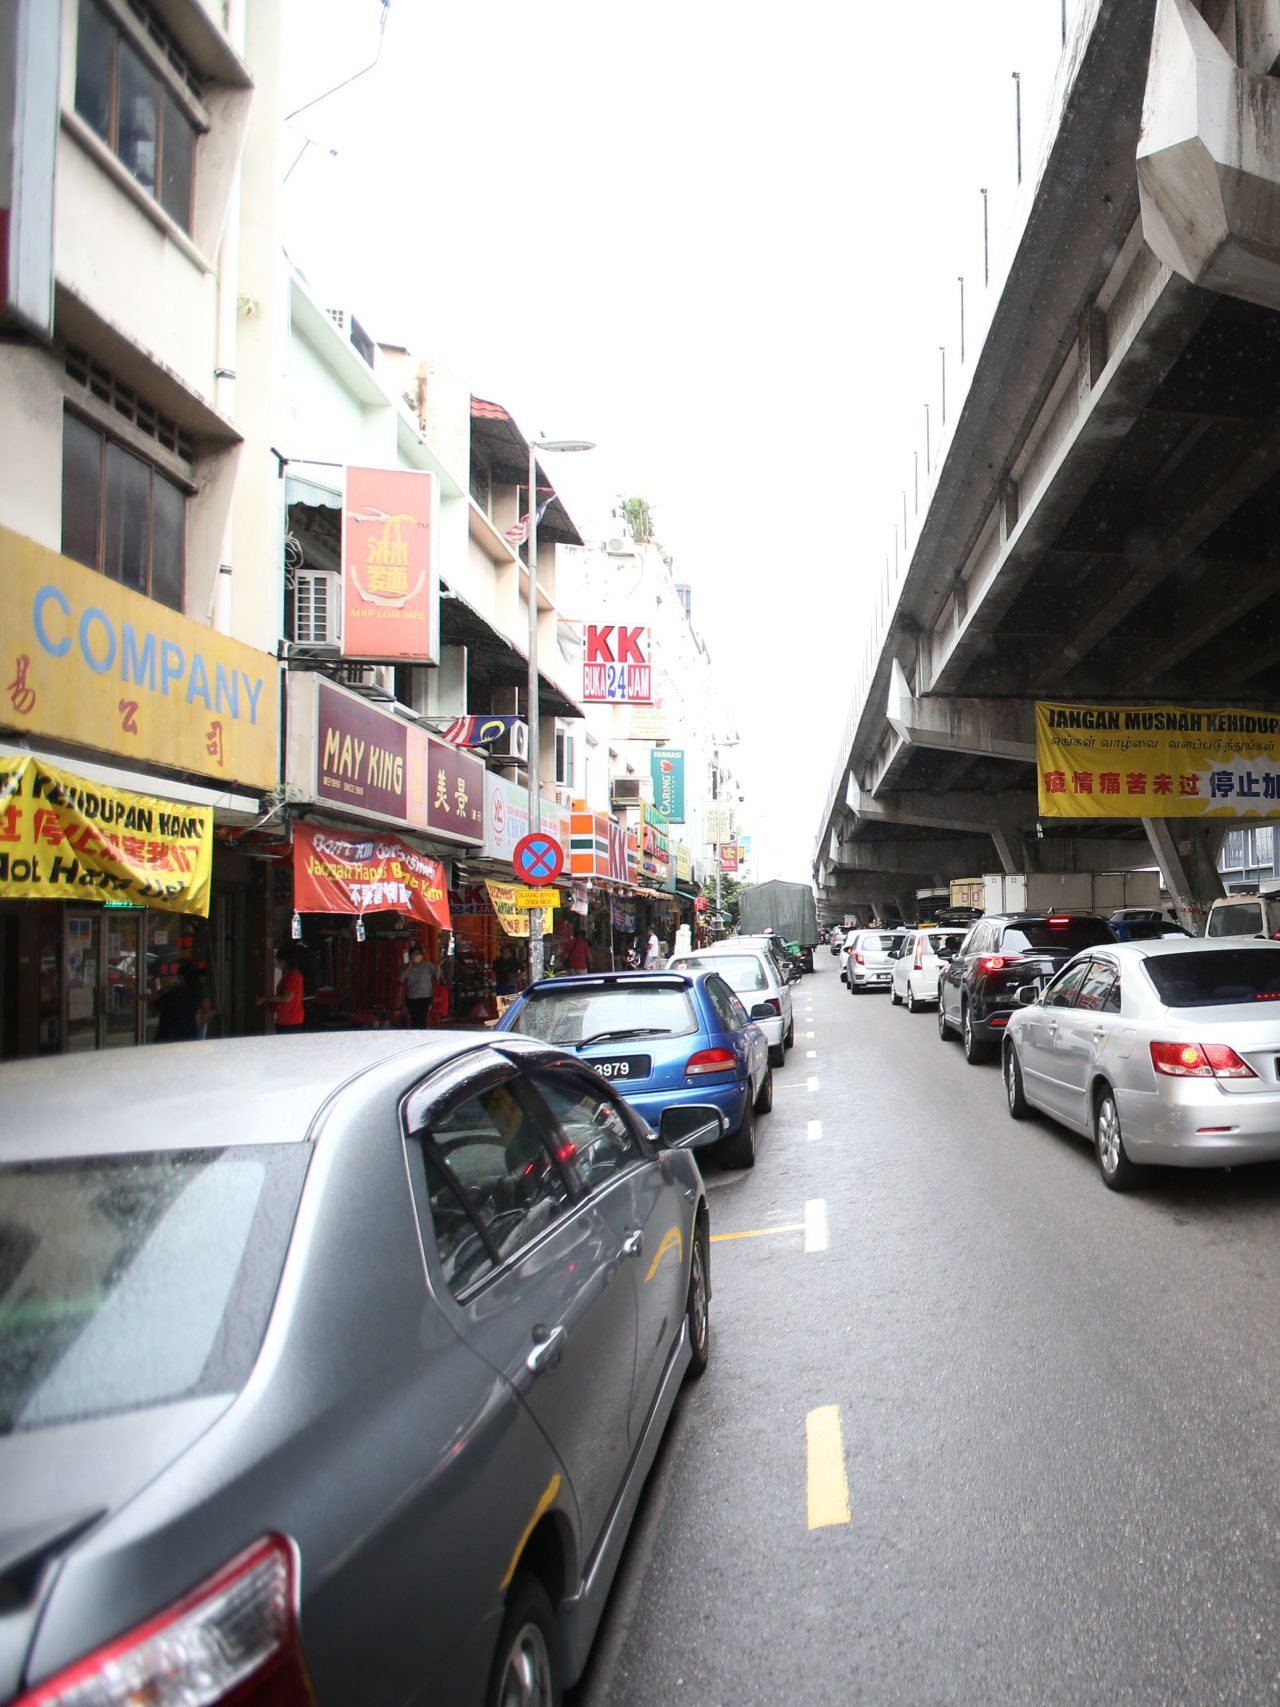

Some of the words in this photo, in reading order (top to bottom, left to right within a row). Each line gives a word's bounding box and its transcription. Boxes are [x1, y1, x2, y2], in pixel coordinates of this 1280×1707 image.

[377, 610, 401, 619] LUM
[403, 611, 425, 621] MEE
[33, 584, 264, 725] COMPANY
[587, 624, 647, 664] KK
[584, 667, 606, 697] BUKA
[607, 664, 626, 699] 24
[628, 666, 650, 698] JAM
[1048, 709, 1121, 731] JANGAN
[1125, 712, 1200, 733] MUSNAH
[323, 727, 365, 781] MAY
[367, 744, 404, 796] KING
[654, 751, 682, 759] FARMASI
[1043, 771, 1200, 796] 疫情痛苦未过
[609, 822, 628, 882] KK
